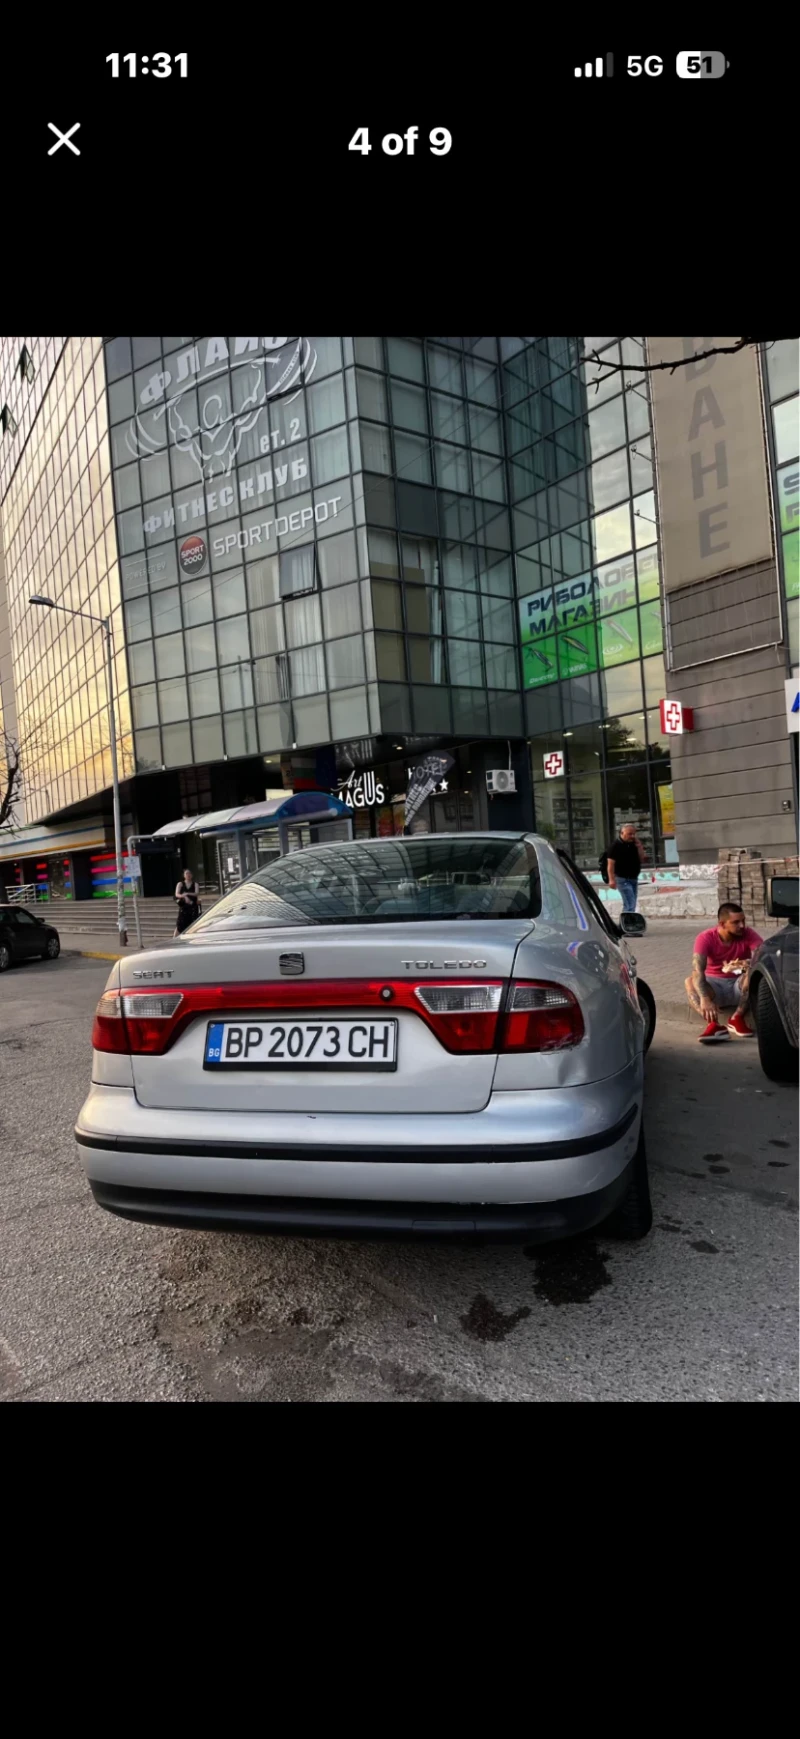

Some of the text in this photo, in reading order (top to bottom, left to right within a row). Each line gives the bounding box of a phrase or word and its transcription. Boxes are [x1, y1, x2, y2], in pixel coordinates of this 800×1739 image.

[289, 417, 302, 442] 2
[143, 457, 309, 534] ФИТНЕС КЛУБ
[181, 544, 204, 559] SPORT
[183, 553, 203, 566] 2000
[401, 959, 487, 970] TOLEDO
[132, 969, 175, 979] SEAT
[224, 1025, 390, 1058] BP 2073 CH
[208, 1047, 221, 1058] BG
